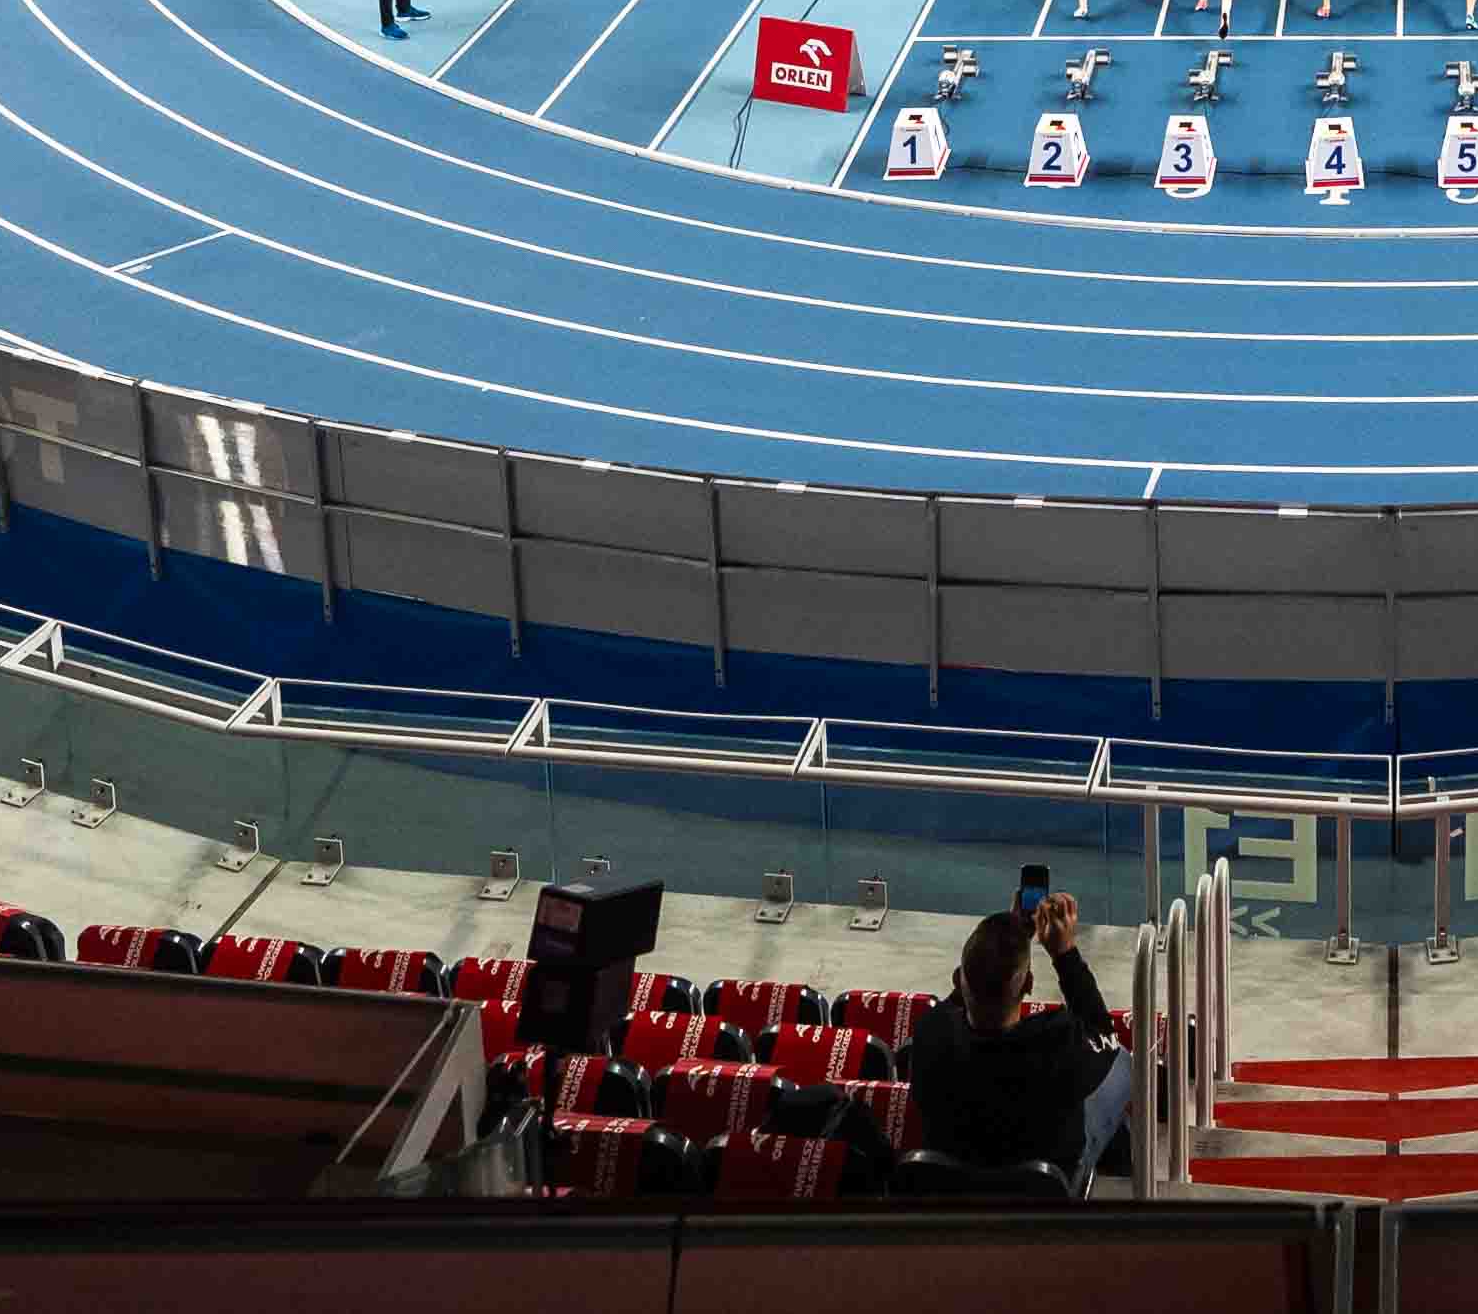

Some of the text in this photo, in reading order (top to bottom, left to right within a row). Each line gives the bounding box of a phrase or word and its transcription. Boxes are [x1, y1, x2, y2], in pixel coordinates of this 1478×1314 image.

[775, 67, 829, 87] ORLEN
[902, 136, 918, 165] 1
[1041, 141, 1062, 171] 2
[1173, 143, 1193, 173] 3
[1324, 145, 1346, 175] 4
[1457, 143, 1478, 173] 5
